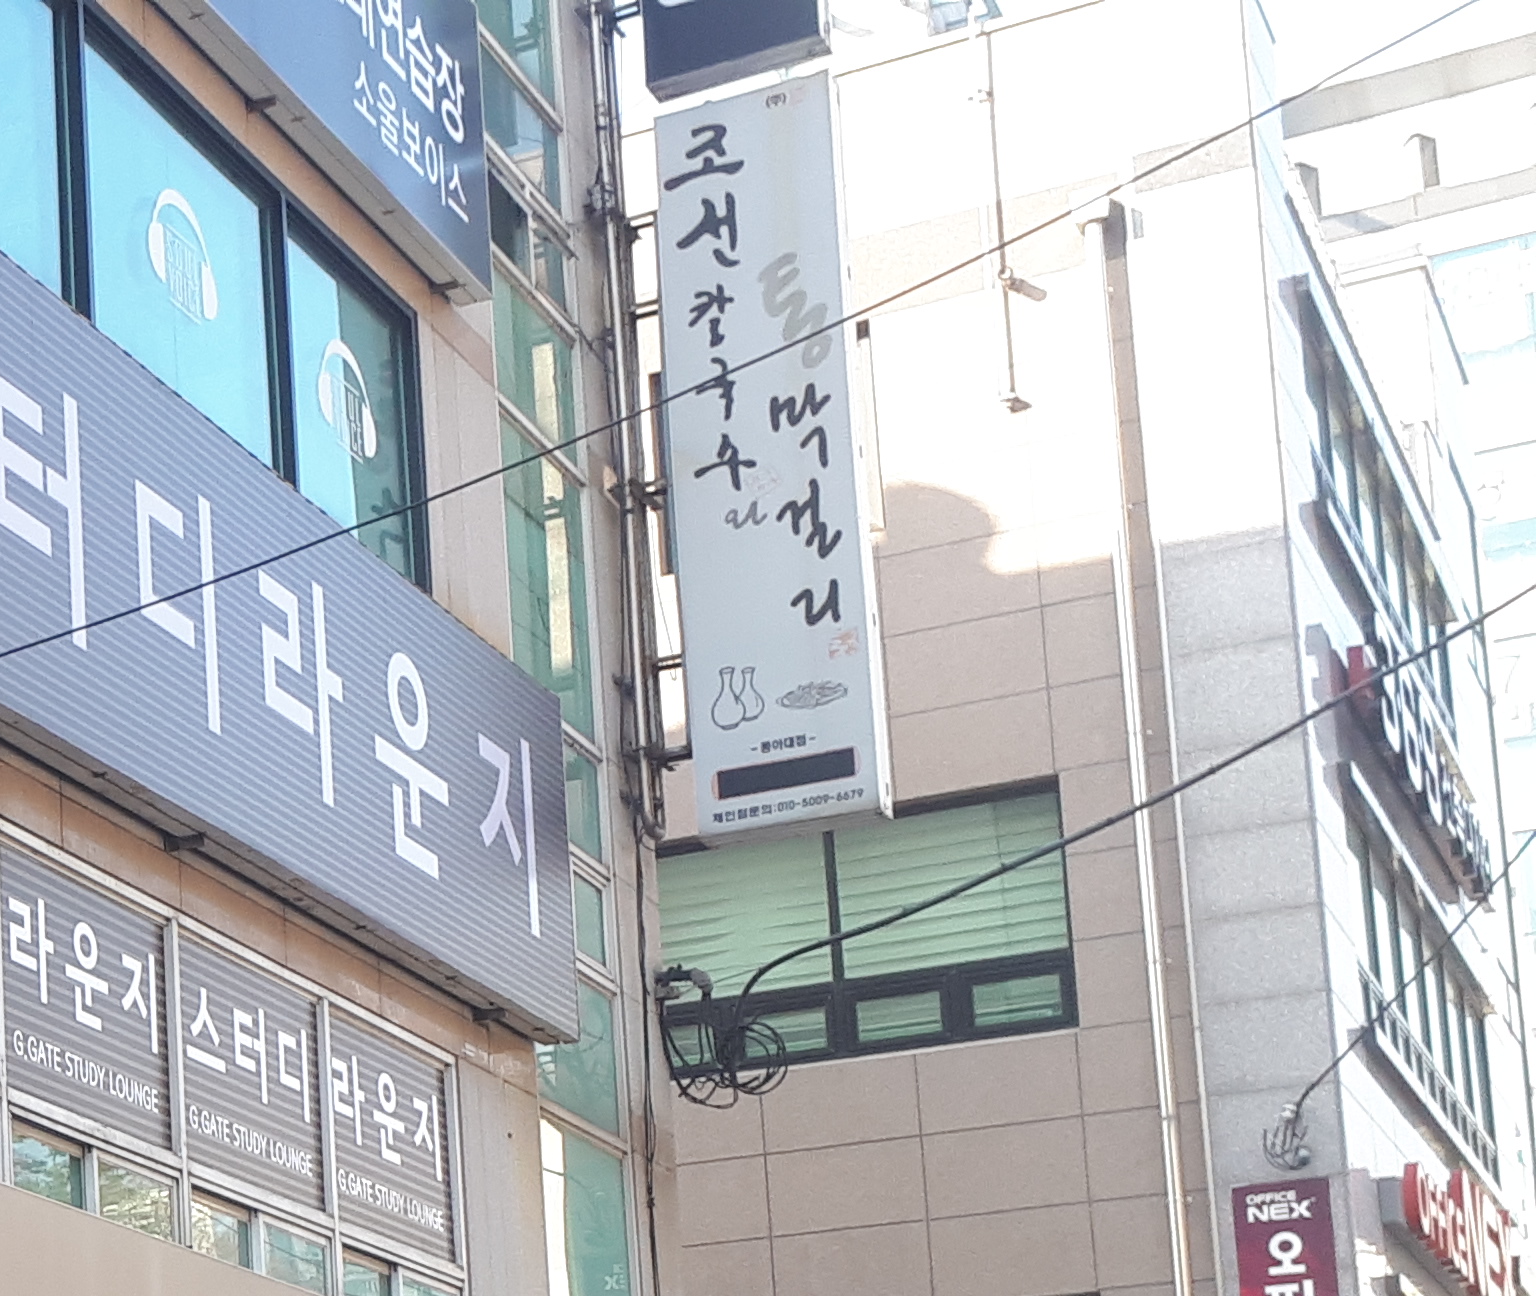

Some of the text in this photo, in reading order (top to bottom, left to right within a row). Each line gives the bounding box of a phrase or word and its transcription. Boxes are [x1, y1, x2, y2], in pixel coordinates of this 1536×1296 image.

[353, 60, 469, 224] 소울보이스
[664, 124, 758, 493] 조선칼국수
[8, 896, 160, 1055] 라운지
[185, 986, 311, 1124] 스터디
[331, 1055, 443, 1182] 라운지
[13, 1029, 159, 1113] G.GATE STUDY LOUNGE
[189, 1105, 313, 1177] G.GATE STUDY LOUNGE
[337, 1168, 444, 1232] G.GATE STUDY LOUNGE
[1245, 1190, 1297, 1205] OFFICE
[1246, 1201, 1313, 1224] NEX
